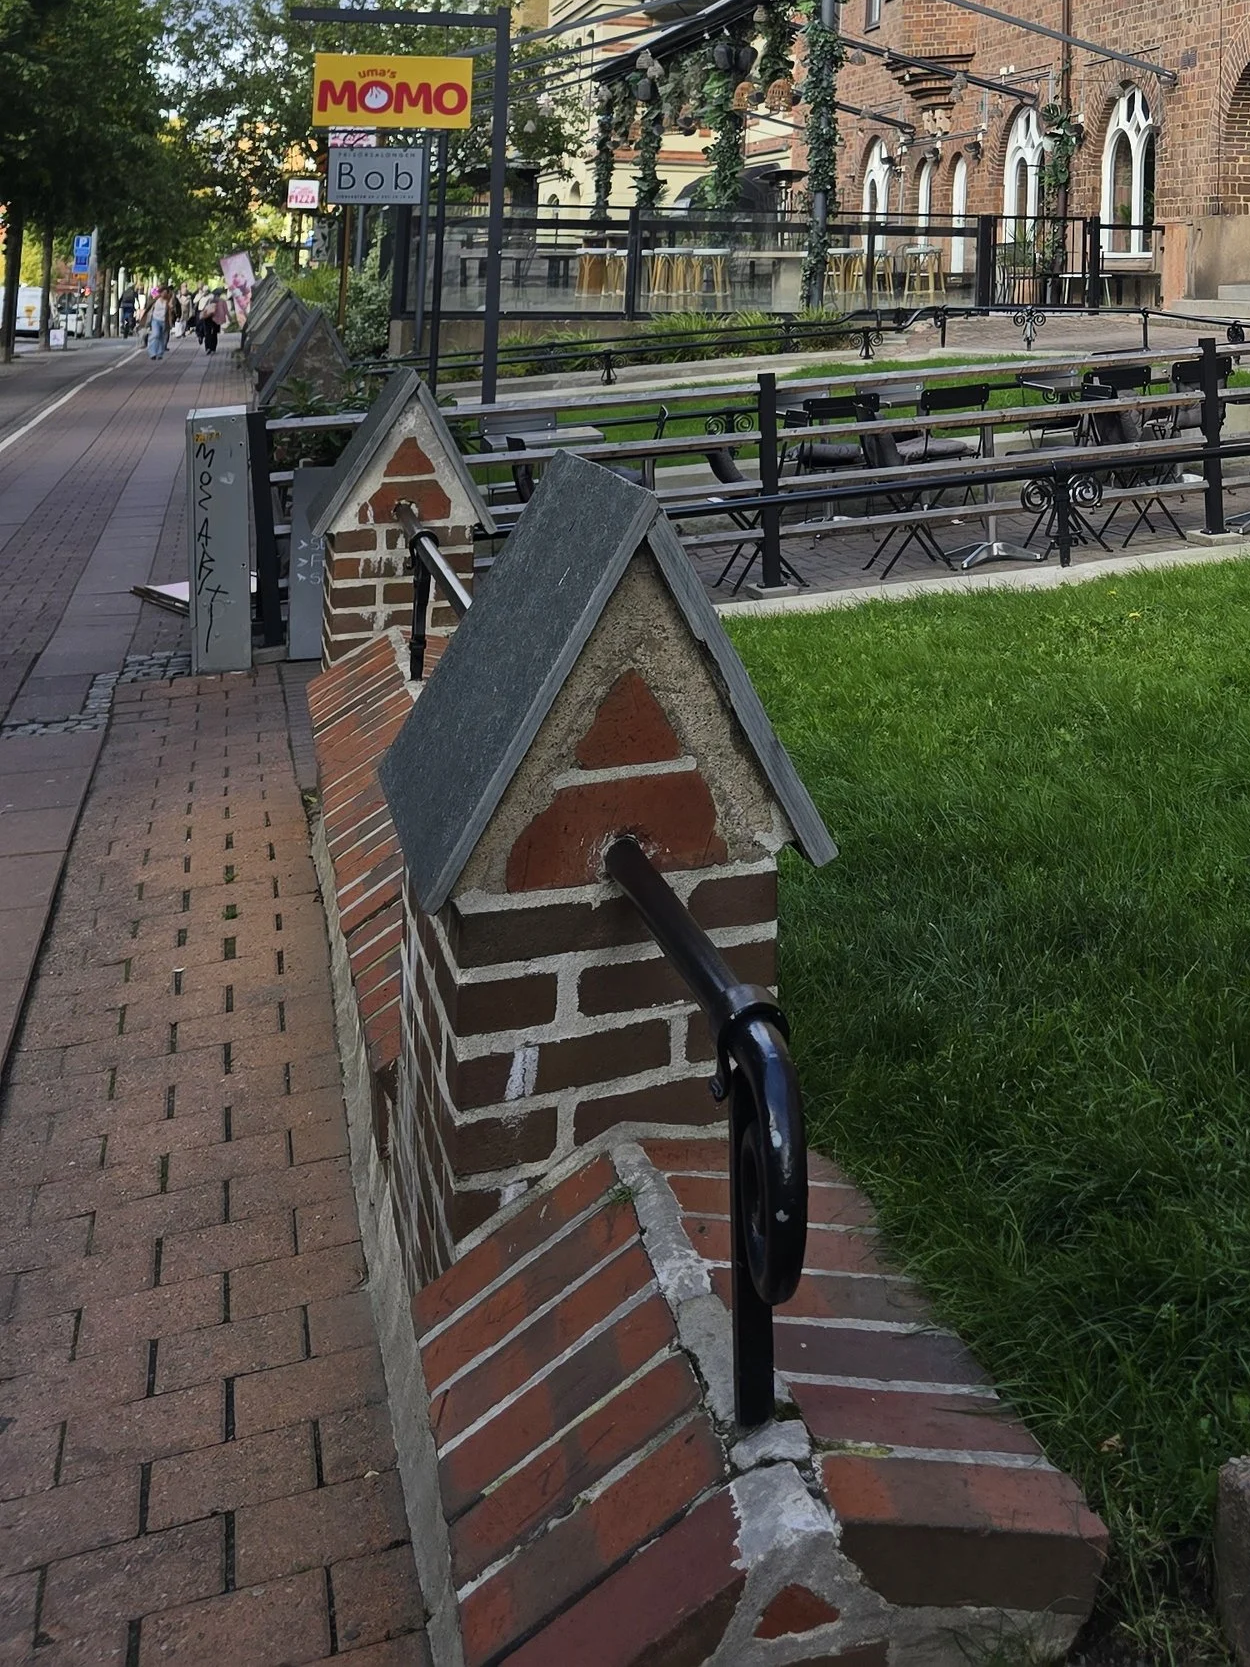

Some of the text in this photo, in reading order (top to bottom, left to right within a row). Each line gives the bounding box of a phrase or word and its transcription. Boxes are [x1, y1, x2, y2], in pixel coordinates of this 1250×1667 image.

[358, 68, 398, 79] uma's
[317, 79, 468, 116] MOMO
[337, 161, 414, 191] Bob
[288, 195, 316, 204] PIZZA
